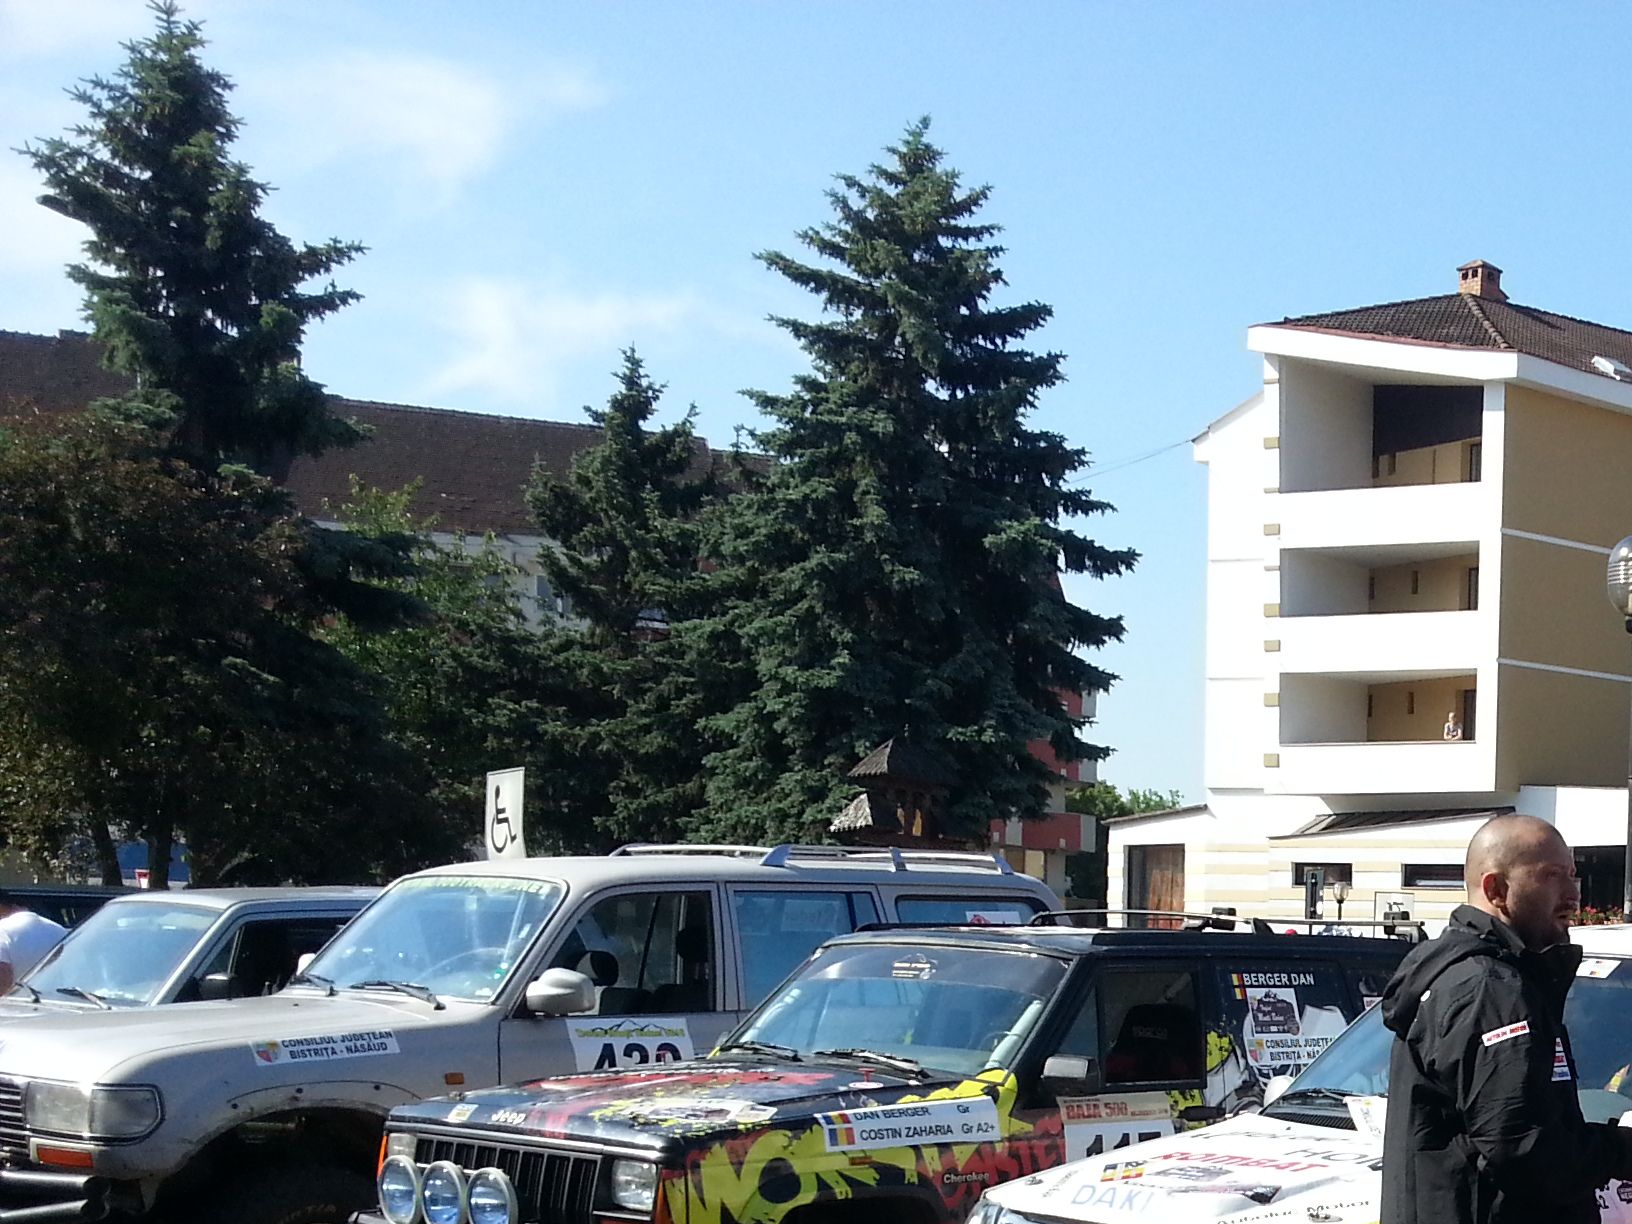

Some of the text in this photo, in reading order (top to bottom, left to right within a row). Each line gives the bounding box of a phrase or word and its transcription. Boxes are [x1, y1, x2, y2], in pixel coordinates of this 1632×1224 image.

[1243, 973, 1315, 985] BERGER DAN
[281, 1035, 338, 1048] CONSILIUL
[490, 1109, 527, 1125] Jeep
[882, 1106, 932, 1119] BERGER
[956, 1104, 971, 1114] Gr
[859, 1120, 996, 1141] COSTIN ZAHARIA Gr A2+
[943, 1172, 990, 1185] Cherokee
